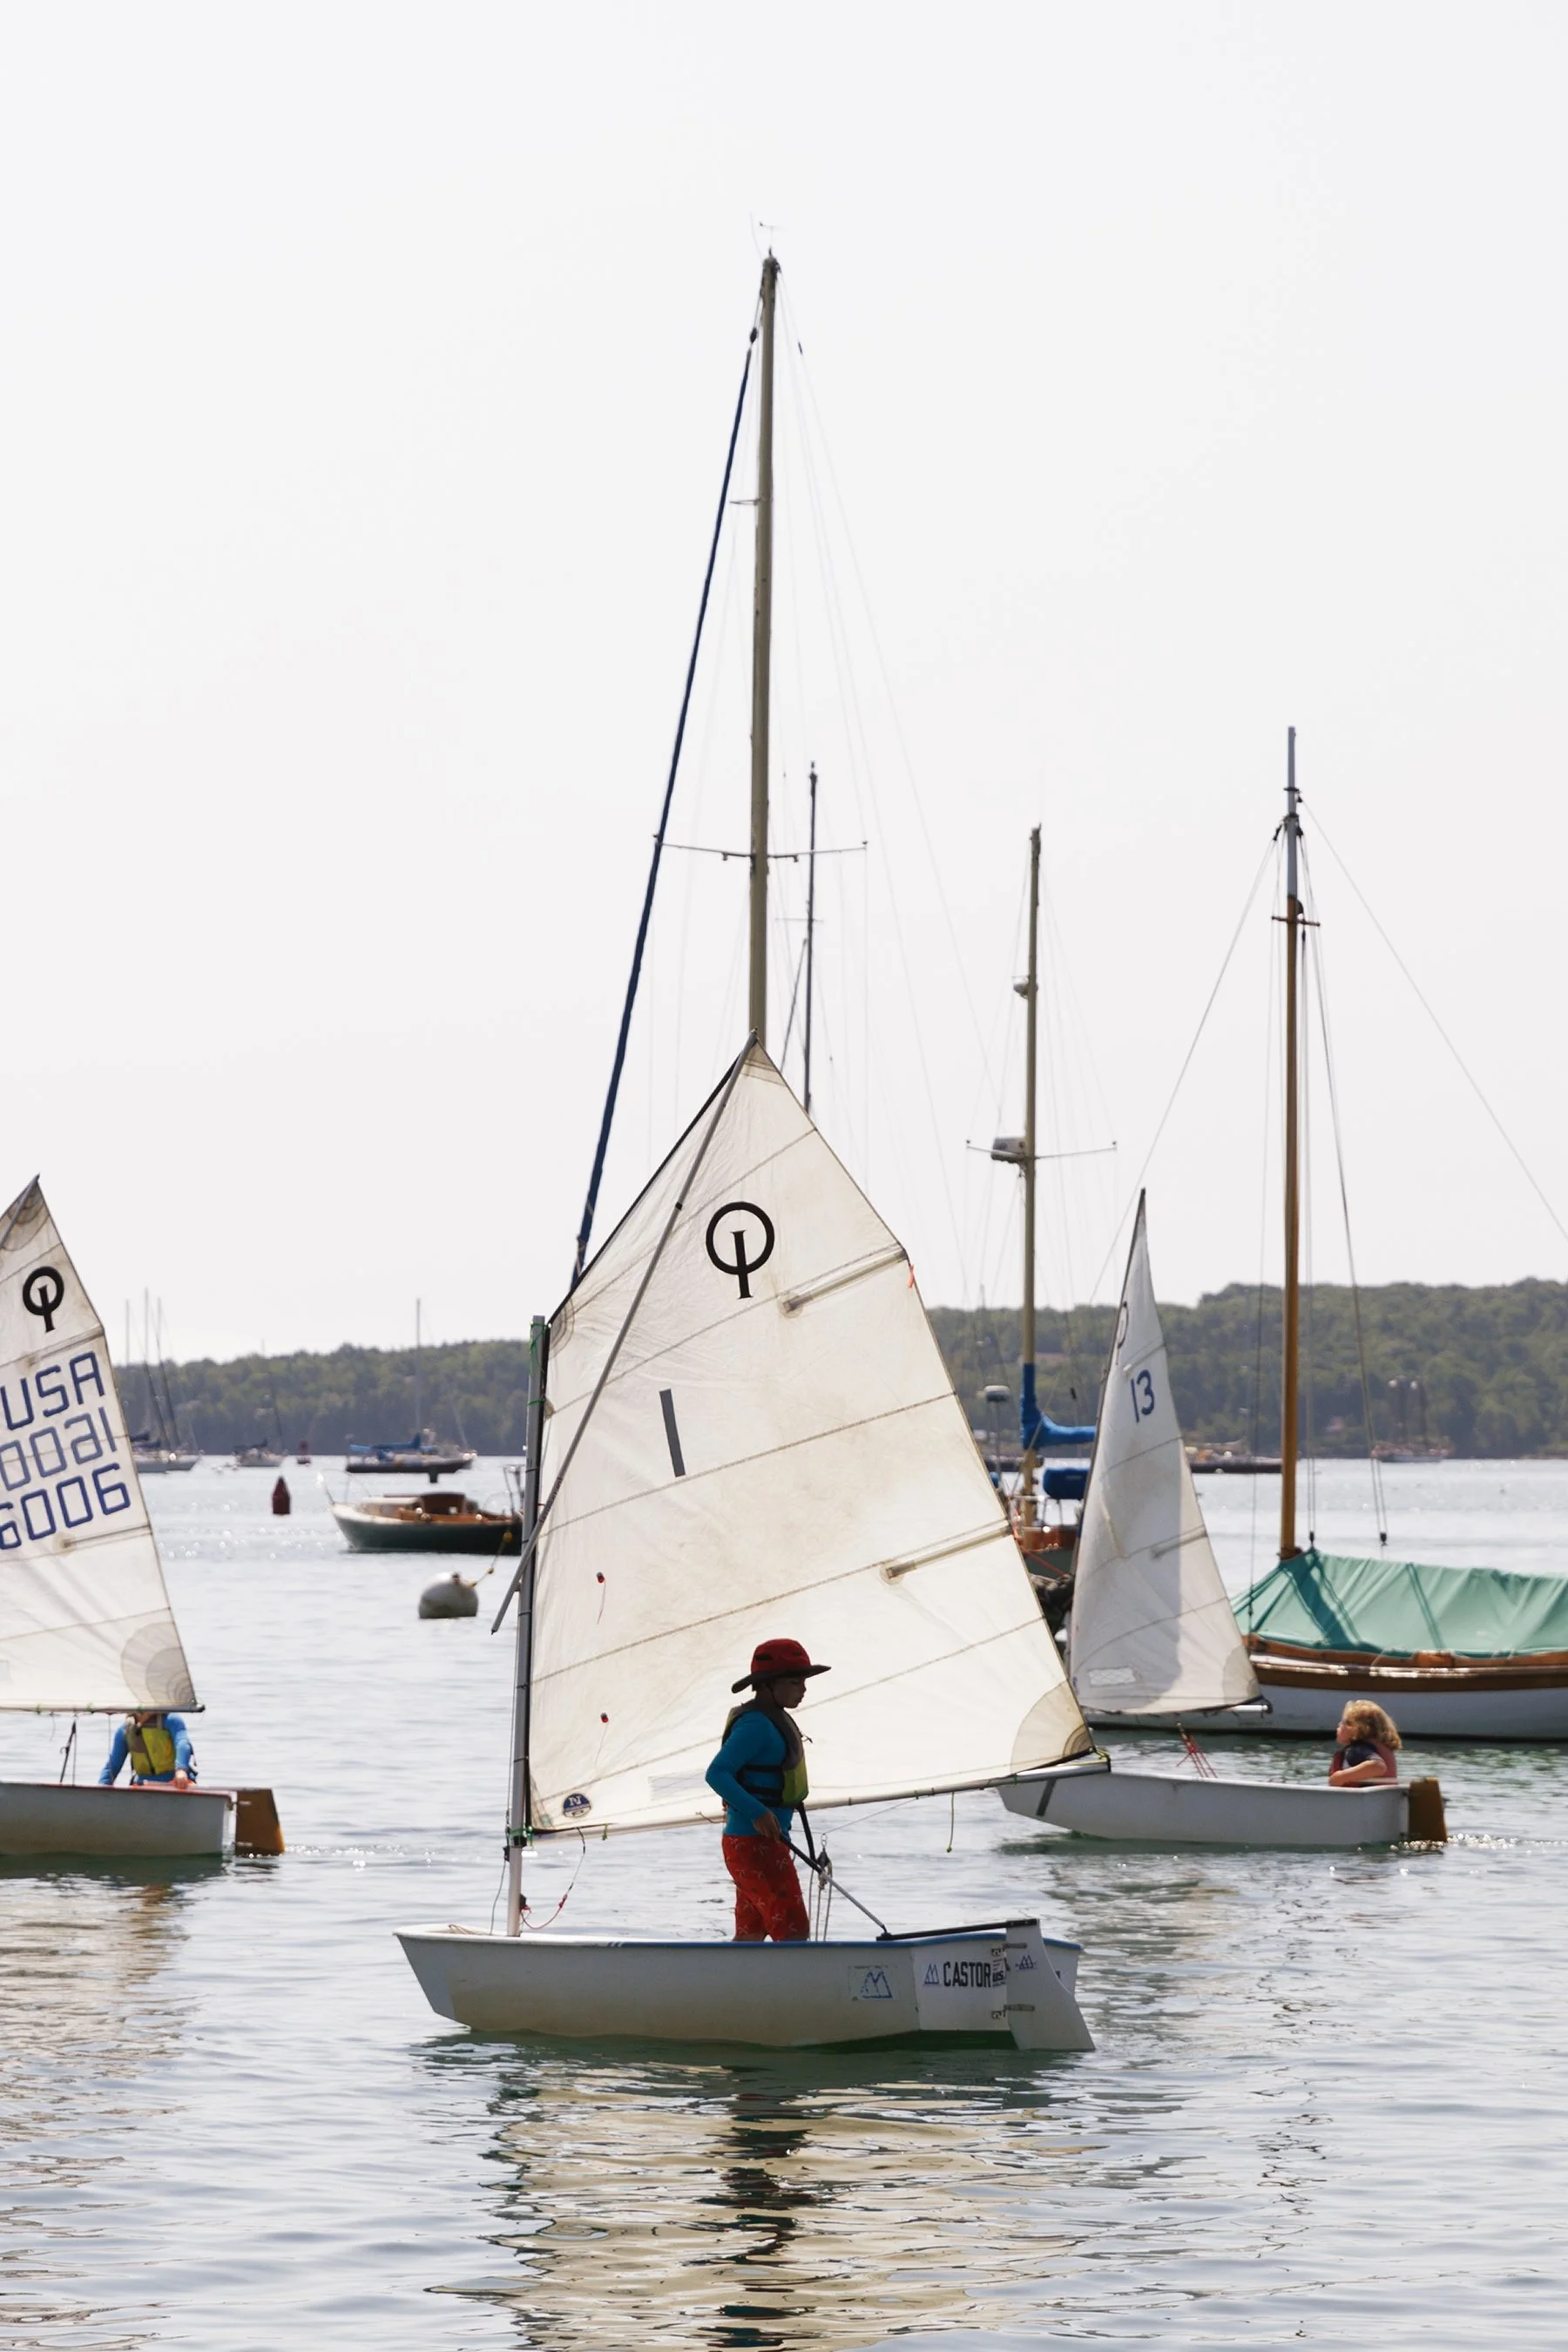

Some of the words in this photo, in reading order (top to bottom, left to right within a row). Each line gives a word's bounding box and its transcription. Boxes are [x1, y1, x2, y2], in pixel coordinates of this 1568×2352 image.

[0, 1350, 105, 1430] USA
[1131, 1369, 1155, 1423] 13
[943, 1961, 991, 1987] CASTOR
